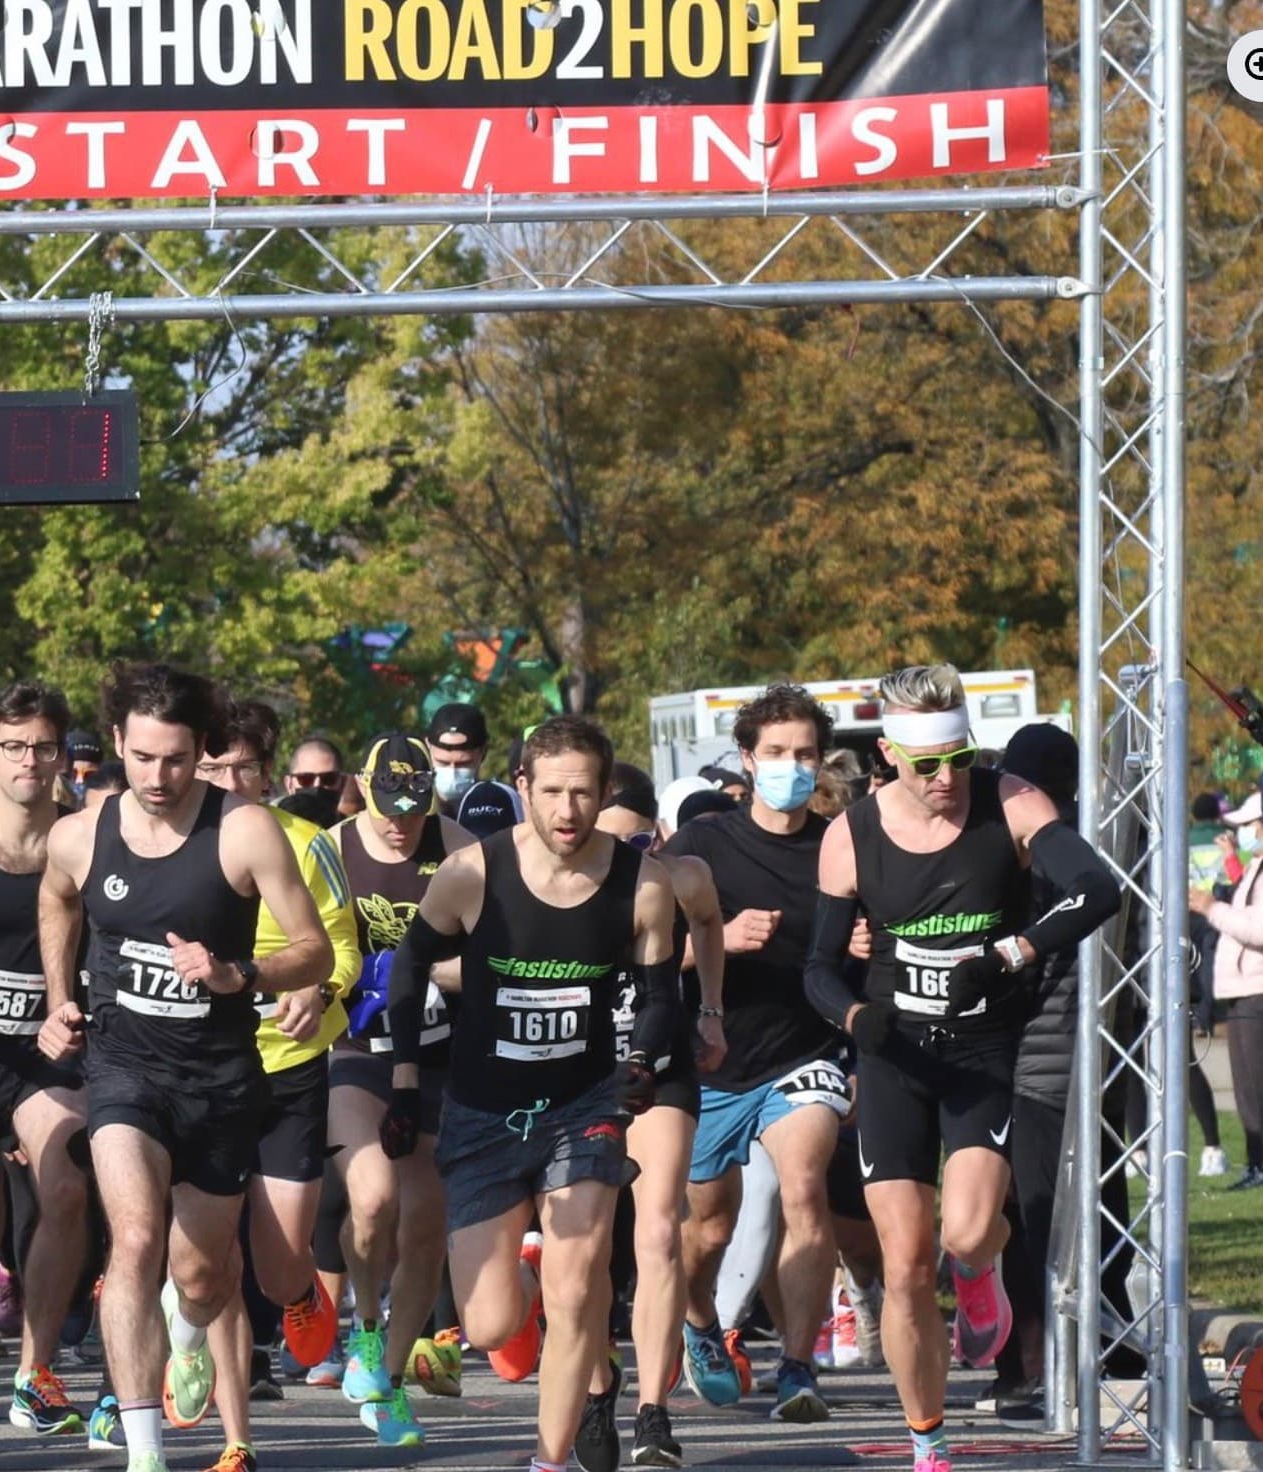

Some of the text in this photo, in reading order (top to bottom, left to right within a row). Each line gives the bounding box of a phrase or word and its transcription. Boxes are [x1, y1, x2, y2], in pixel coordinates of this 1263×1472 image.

[344, 0, 824, 81] ROAD2HOPE
[460, 118, 492, 190] /
[551, 98, 1005, 184] FINISH
[906, 966, 950, 997] 166
[510, 1010, 577, 1041] 1610
